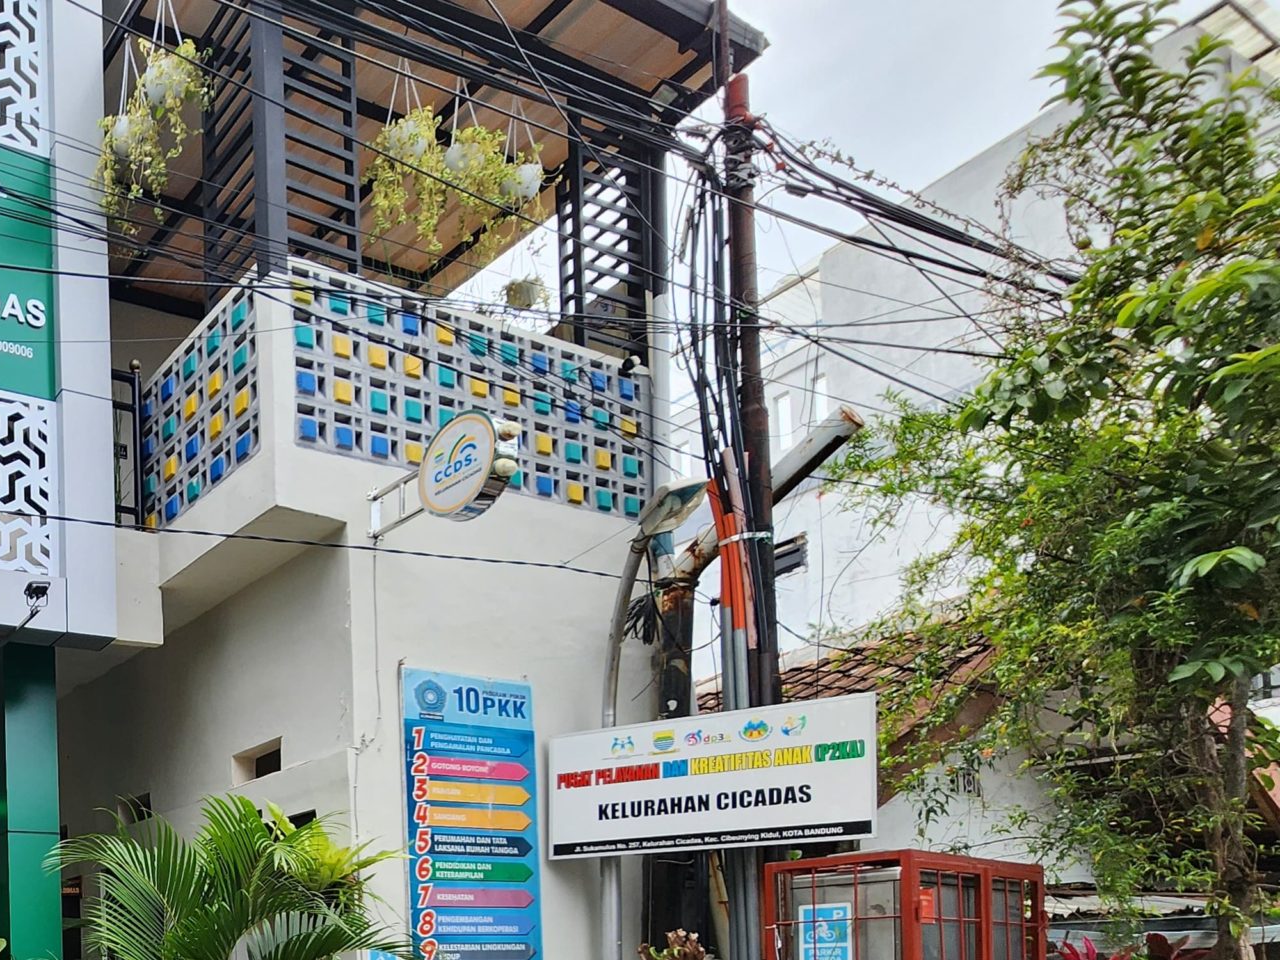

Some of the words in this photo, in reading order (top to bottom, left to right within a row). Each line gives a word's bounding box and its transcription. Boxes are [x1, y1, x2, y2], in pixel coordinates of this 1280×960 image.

[453, 686, 480, 714] 10
[483, 697, 526, 719] PKK
[412, 726, 425, 750] 1
[411, 751, 430, 776] 2
[557, 770, 593, 790] PUSAT
[595, 762, 660, 786] PELAYANAN
[662, 759, 688, 779] DAN
[691, 749, 772, 775] KREATIFITAS
[773, 745, 812, 768] ANAK
[814, 739, 865, 762] (P2KA)
[413, 776, 430, 800] 3
[414, 802, 431, 827] 4
[598, 794, 710, 821] KELURAHAN
[716, 784, 812, 810] CICADAS
[415, 829, 431, 854] 5
[782, 829, 803, 838] KOTA
[804, 826, 843, 836] BANDUNG
[416, 856, 433, 880] 6
[417, 883, 433, 908] 7
[417, 910, 436, 937] 8
